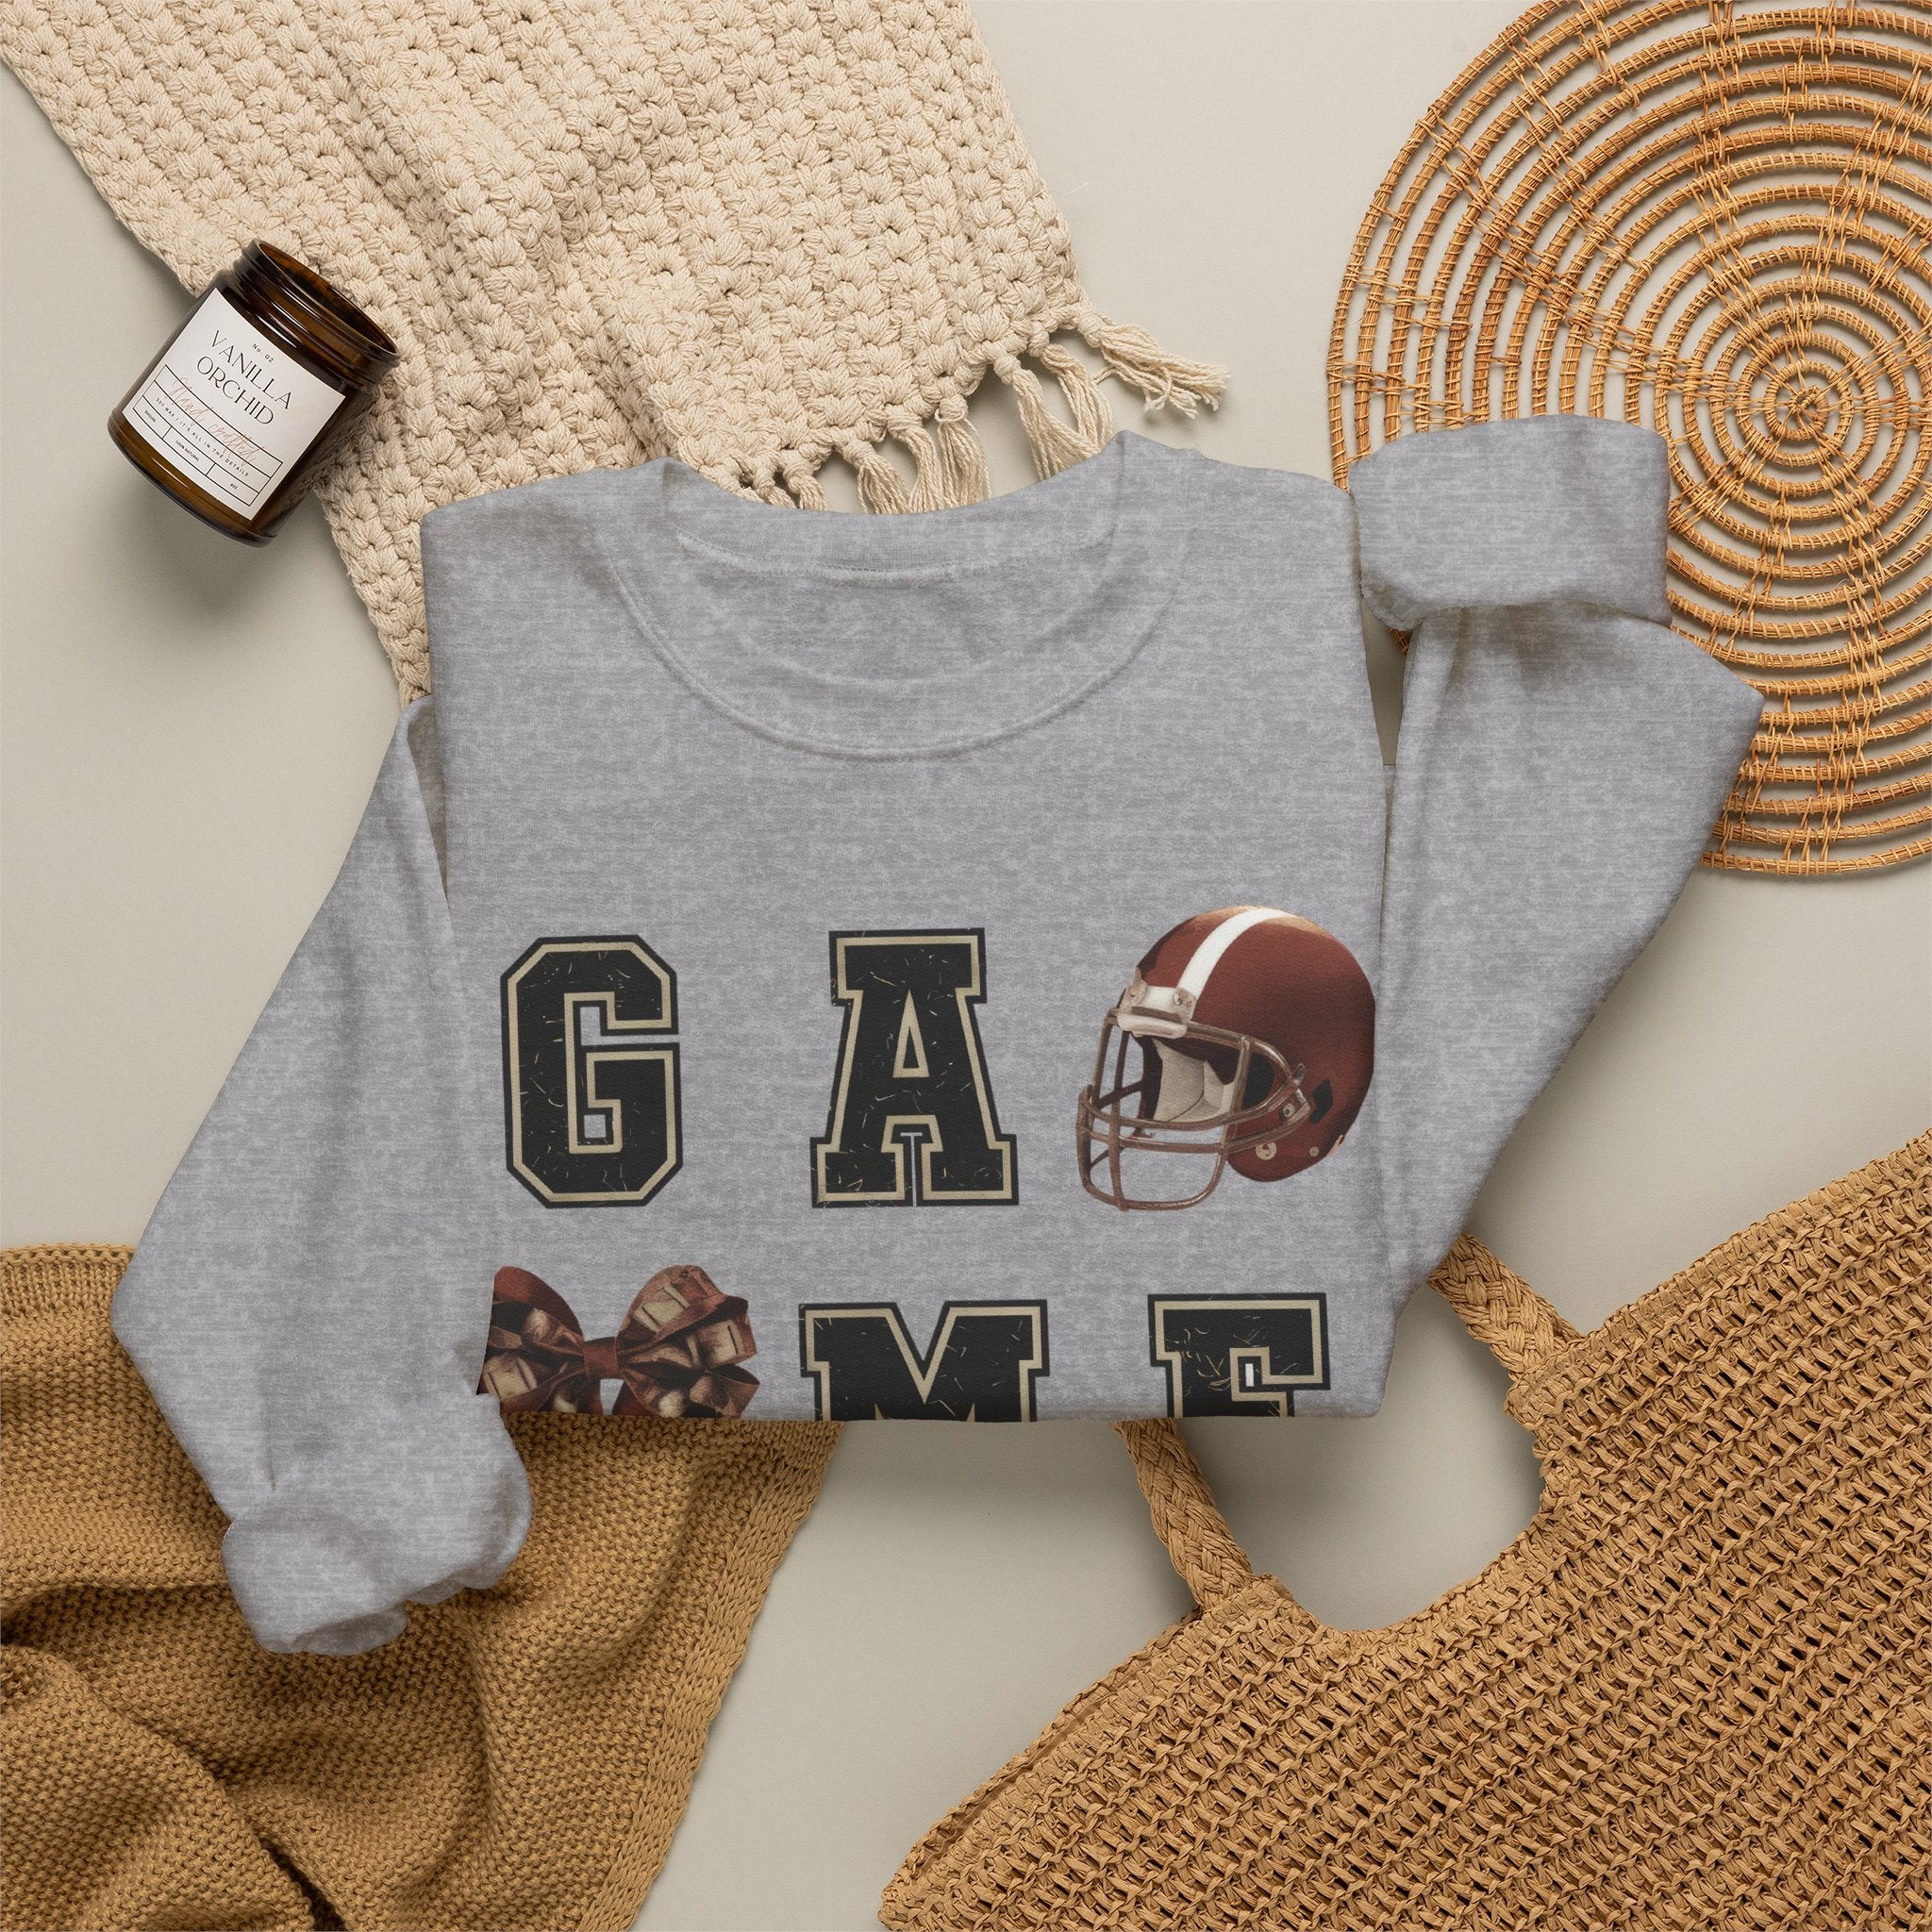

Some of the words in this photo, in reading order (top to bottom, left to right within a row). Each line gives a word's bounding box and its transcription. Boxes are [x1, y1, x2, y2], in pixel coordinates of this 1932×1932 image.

[210, 329, 291, 410] VANILLA
[264, 354, 275, 363] 02
[196, 356, 275, 425] ORCHID
[191, 430, 202, 441] ALL
[203, 441, 211, 449] IN
[211, 448, 225, 459] THE
[224, 458, 249, 476] DETAILS
